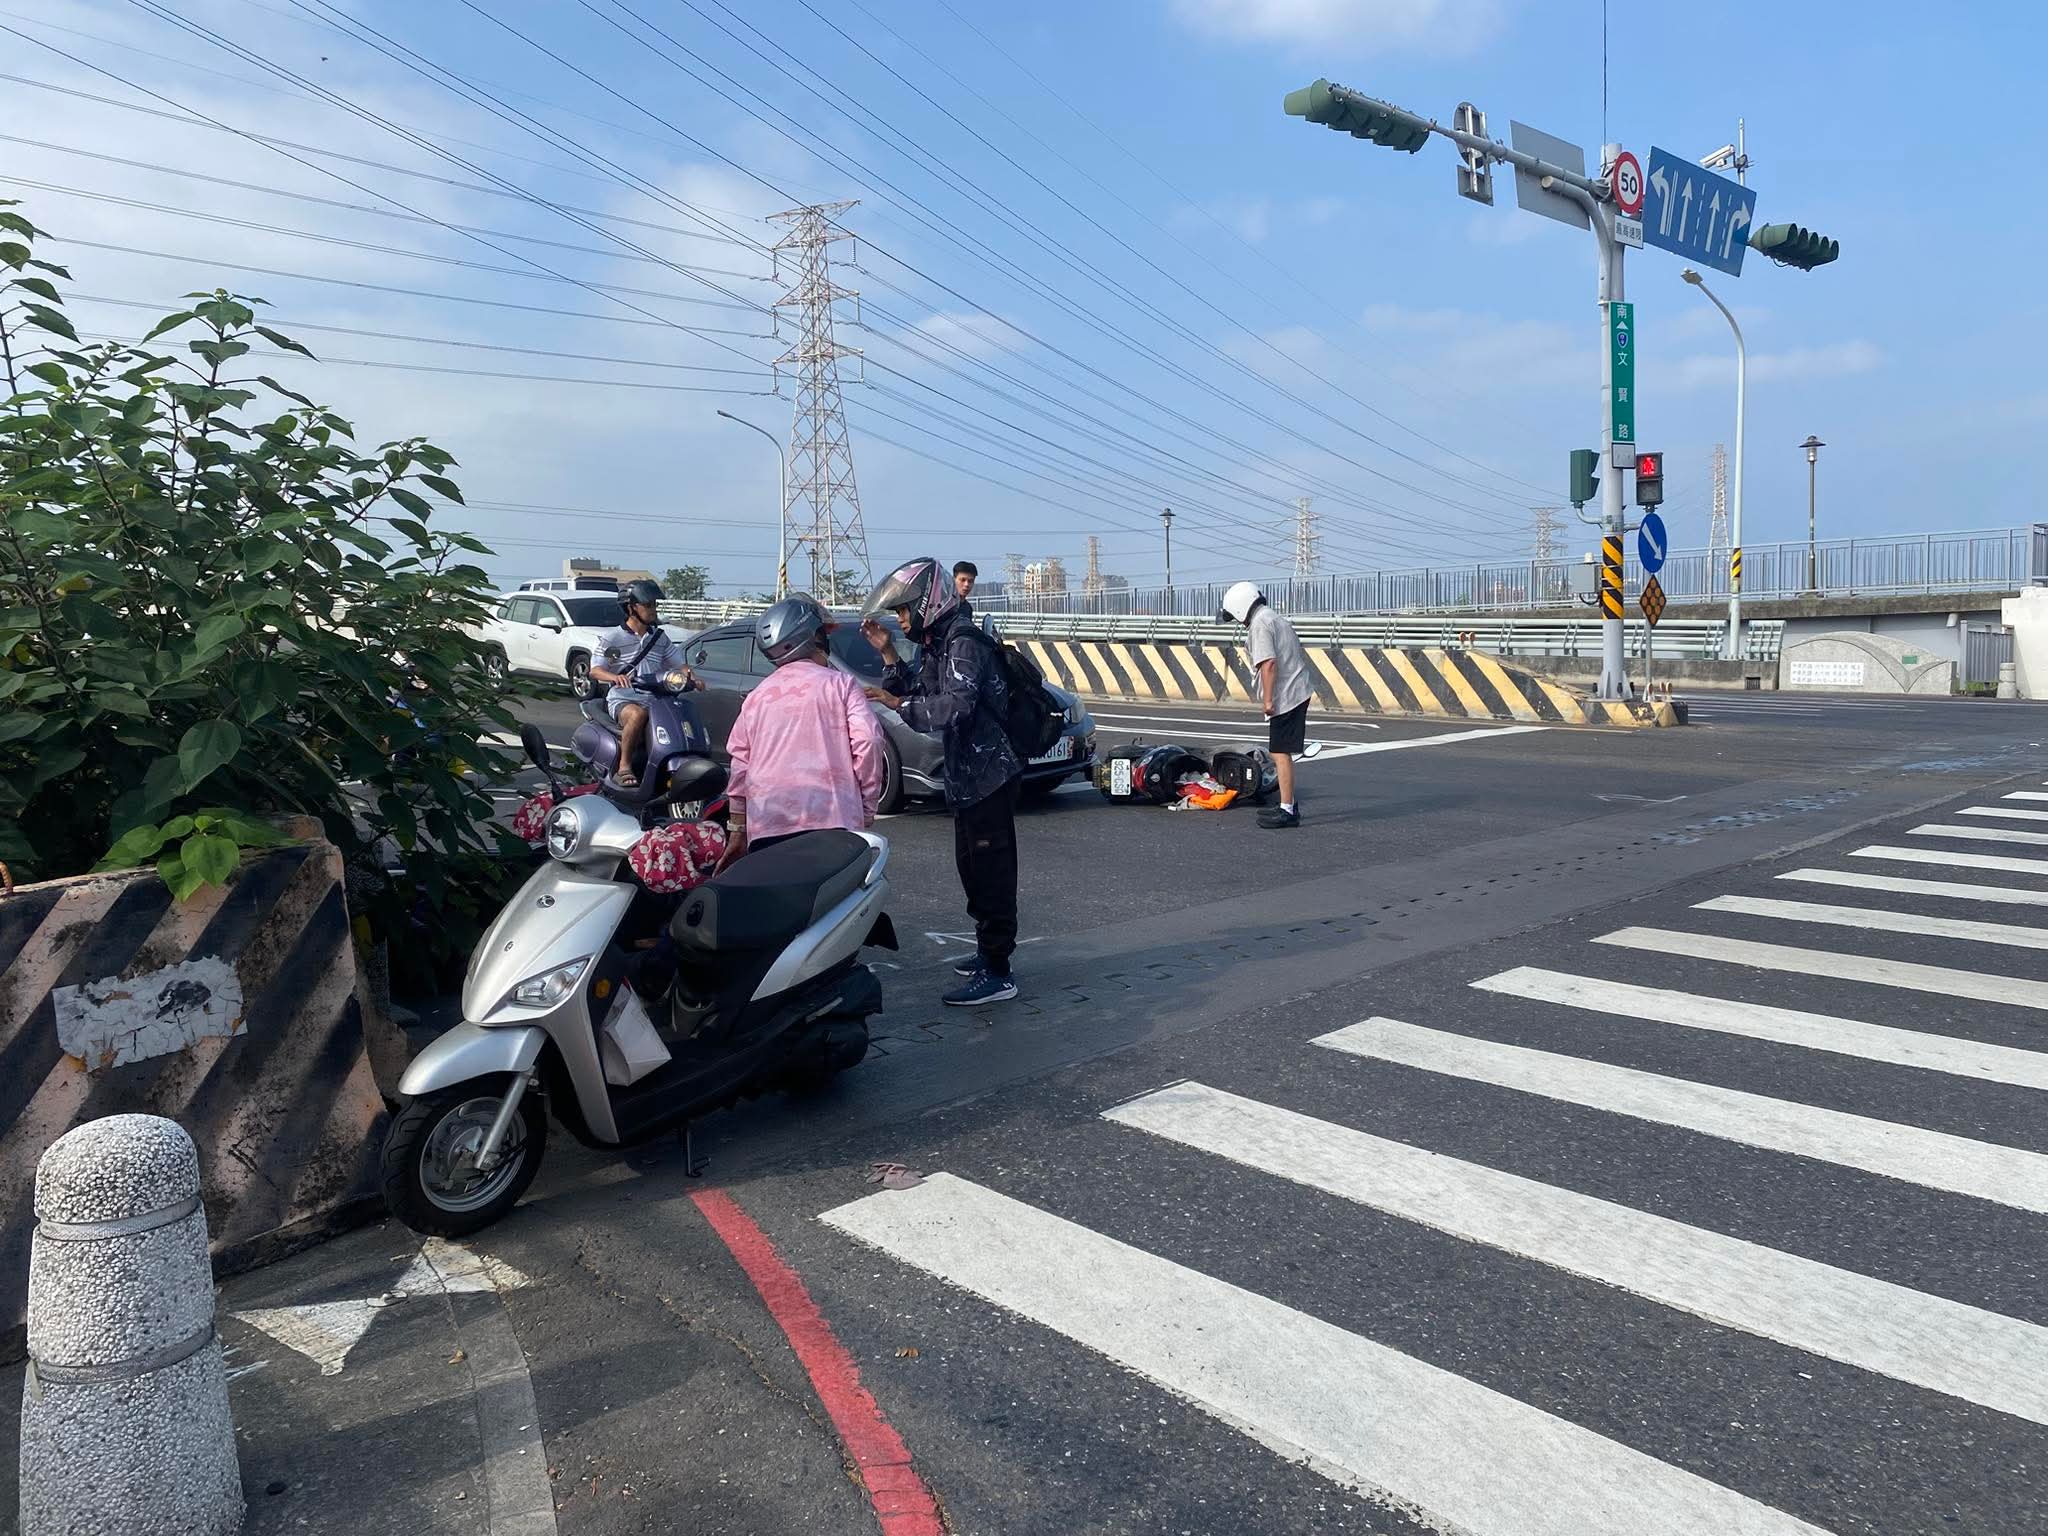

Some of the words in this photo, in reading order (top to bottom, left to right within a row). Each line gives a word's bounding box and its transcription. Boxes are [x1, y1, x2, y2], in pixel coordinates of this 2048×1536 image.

[1621, 172, 1638, 195] 50
[1616, 304, 1628, 319] 南
[1617, 351, 1629, 439] 文賢路
